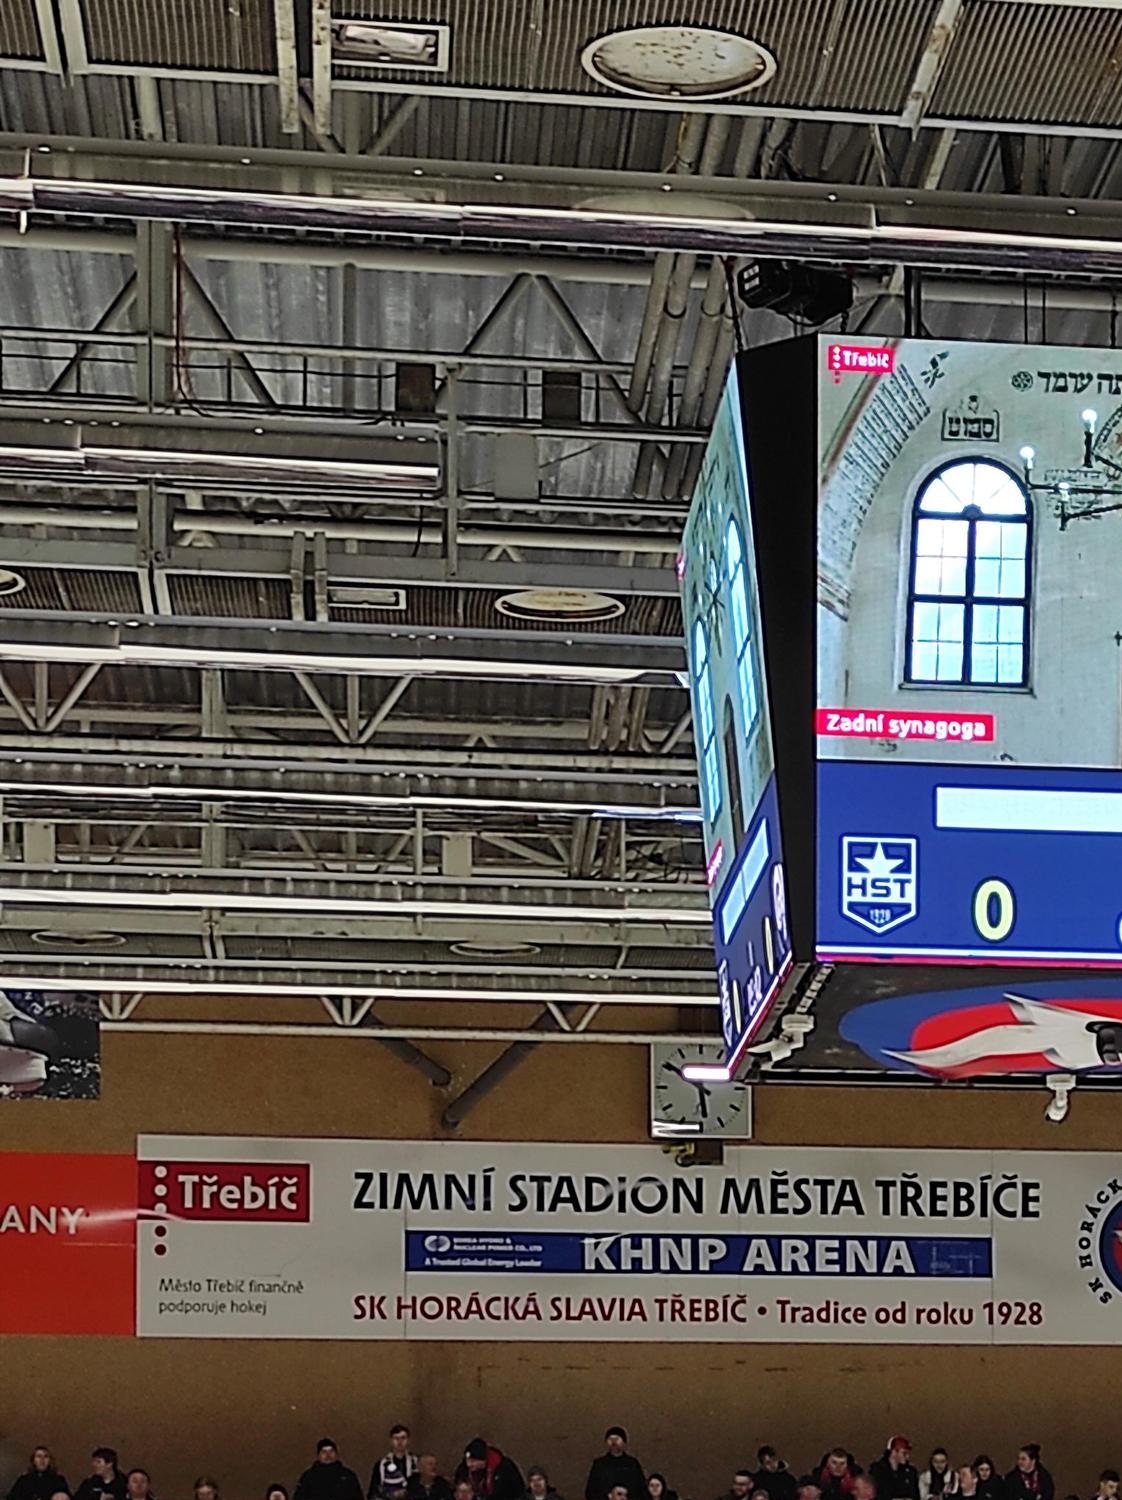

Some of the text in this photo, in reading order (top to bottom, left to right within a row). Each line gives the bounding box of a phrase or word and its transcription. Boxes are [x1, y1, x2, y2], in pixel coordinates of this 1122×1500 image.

[826, 713, 986, 740] Zadní synagoga
[847, 877, 912, 898] HST
[974, 880, 1014, 940] 0
[177, 1175, 299, 1210] Třebíč
[353, 1167, 495, 1211] ZIMNÍ
[719, 1170, 865, 1215] MĚSTA
[875, 1172, 1041, 1218] TŘEBÍČE
[583, 1237, 916, 1274] KHNP ARENA
[158, 1277, 304, 1294] Město Třebíč finančně
[158, 1300, 267, 1316] podporuje hokej
[353, 1292, 1042, 1326] SK HORÁCKÁ SLAVIA TŘEBÍČ Tradice od roku 1928
